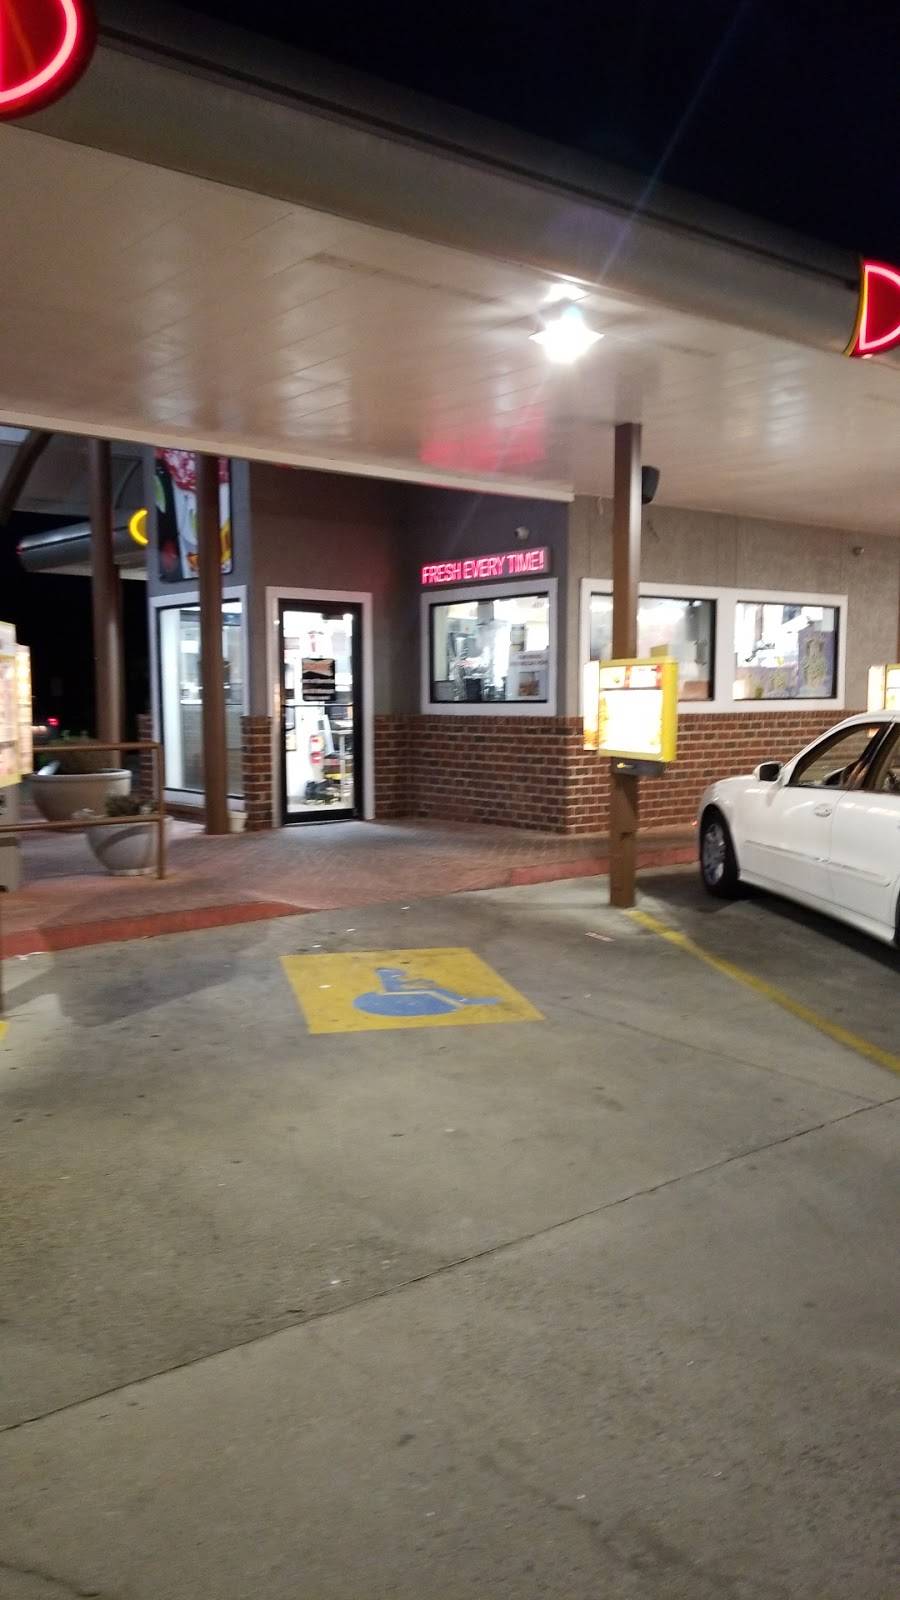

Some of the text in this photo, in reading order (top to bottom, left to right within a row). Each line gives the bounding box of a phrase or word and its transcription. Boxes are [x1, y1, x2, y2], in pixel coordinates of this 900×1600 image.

[422, 549, 544, 584] FRESH EVERY TIME!
